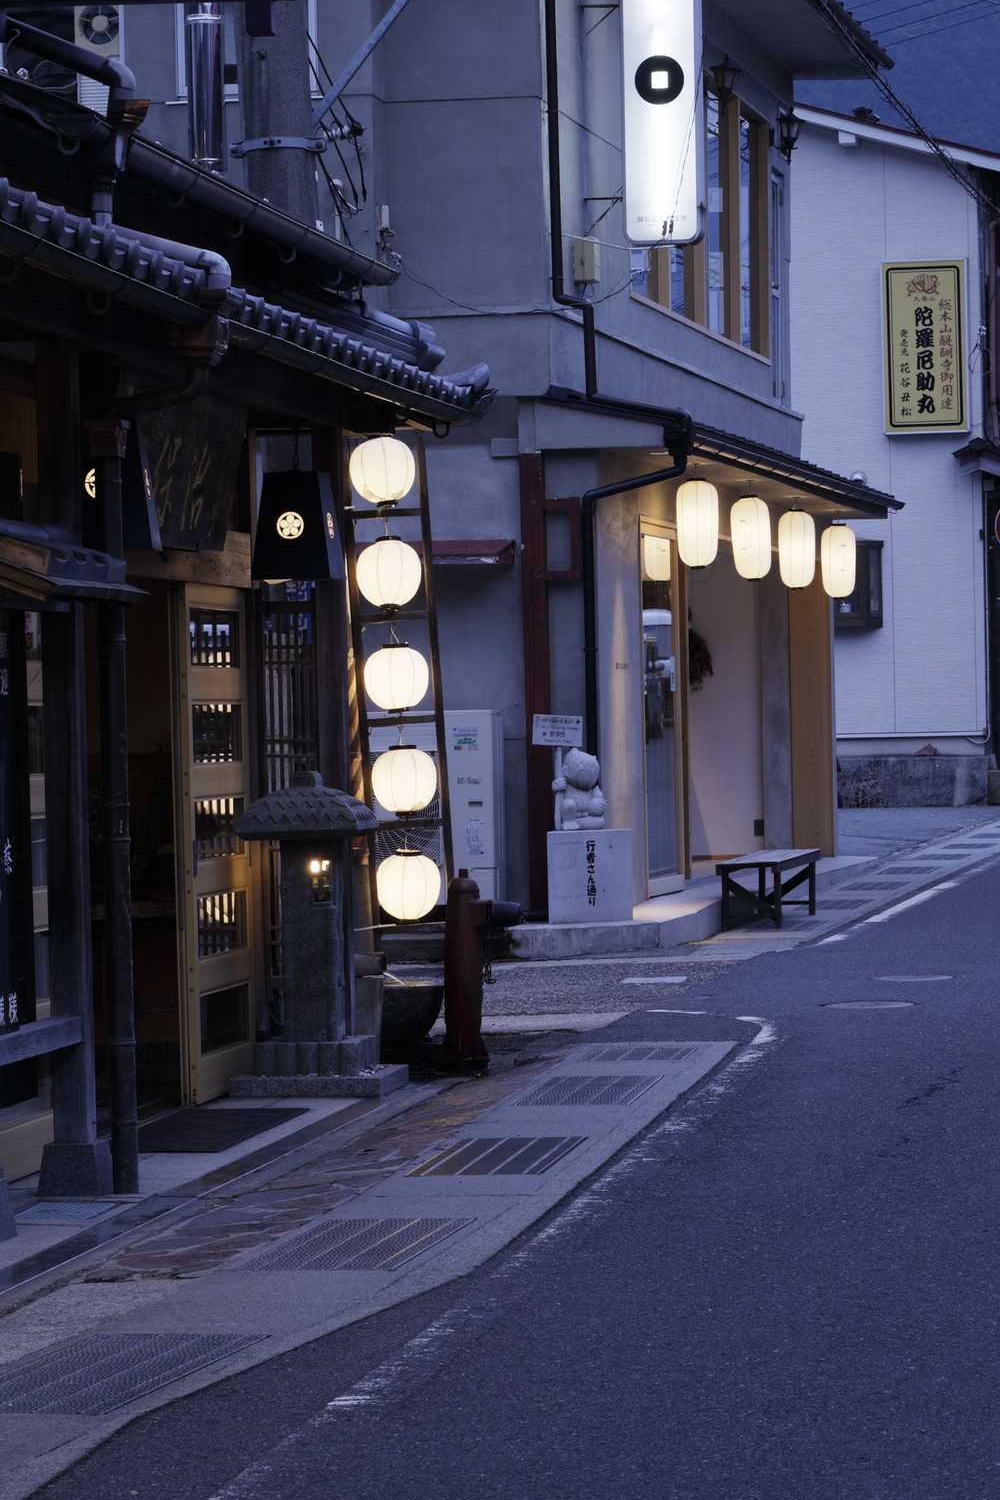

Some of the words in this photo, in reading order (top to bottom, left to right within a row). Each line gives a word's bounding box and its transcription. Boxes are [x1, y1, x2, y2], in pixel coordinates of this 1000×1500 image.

[899, 328, 909, 357] 発売元
[914, 306, 936, 414] 陀羅尼助丸
[938, 298, 955, 411] 総本山醍醐寺御用達
[585, 839, 597, 907] 行者さん通り
